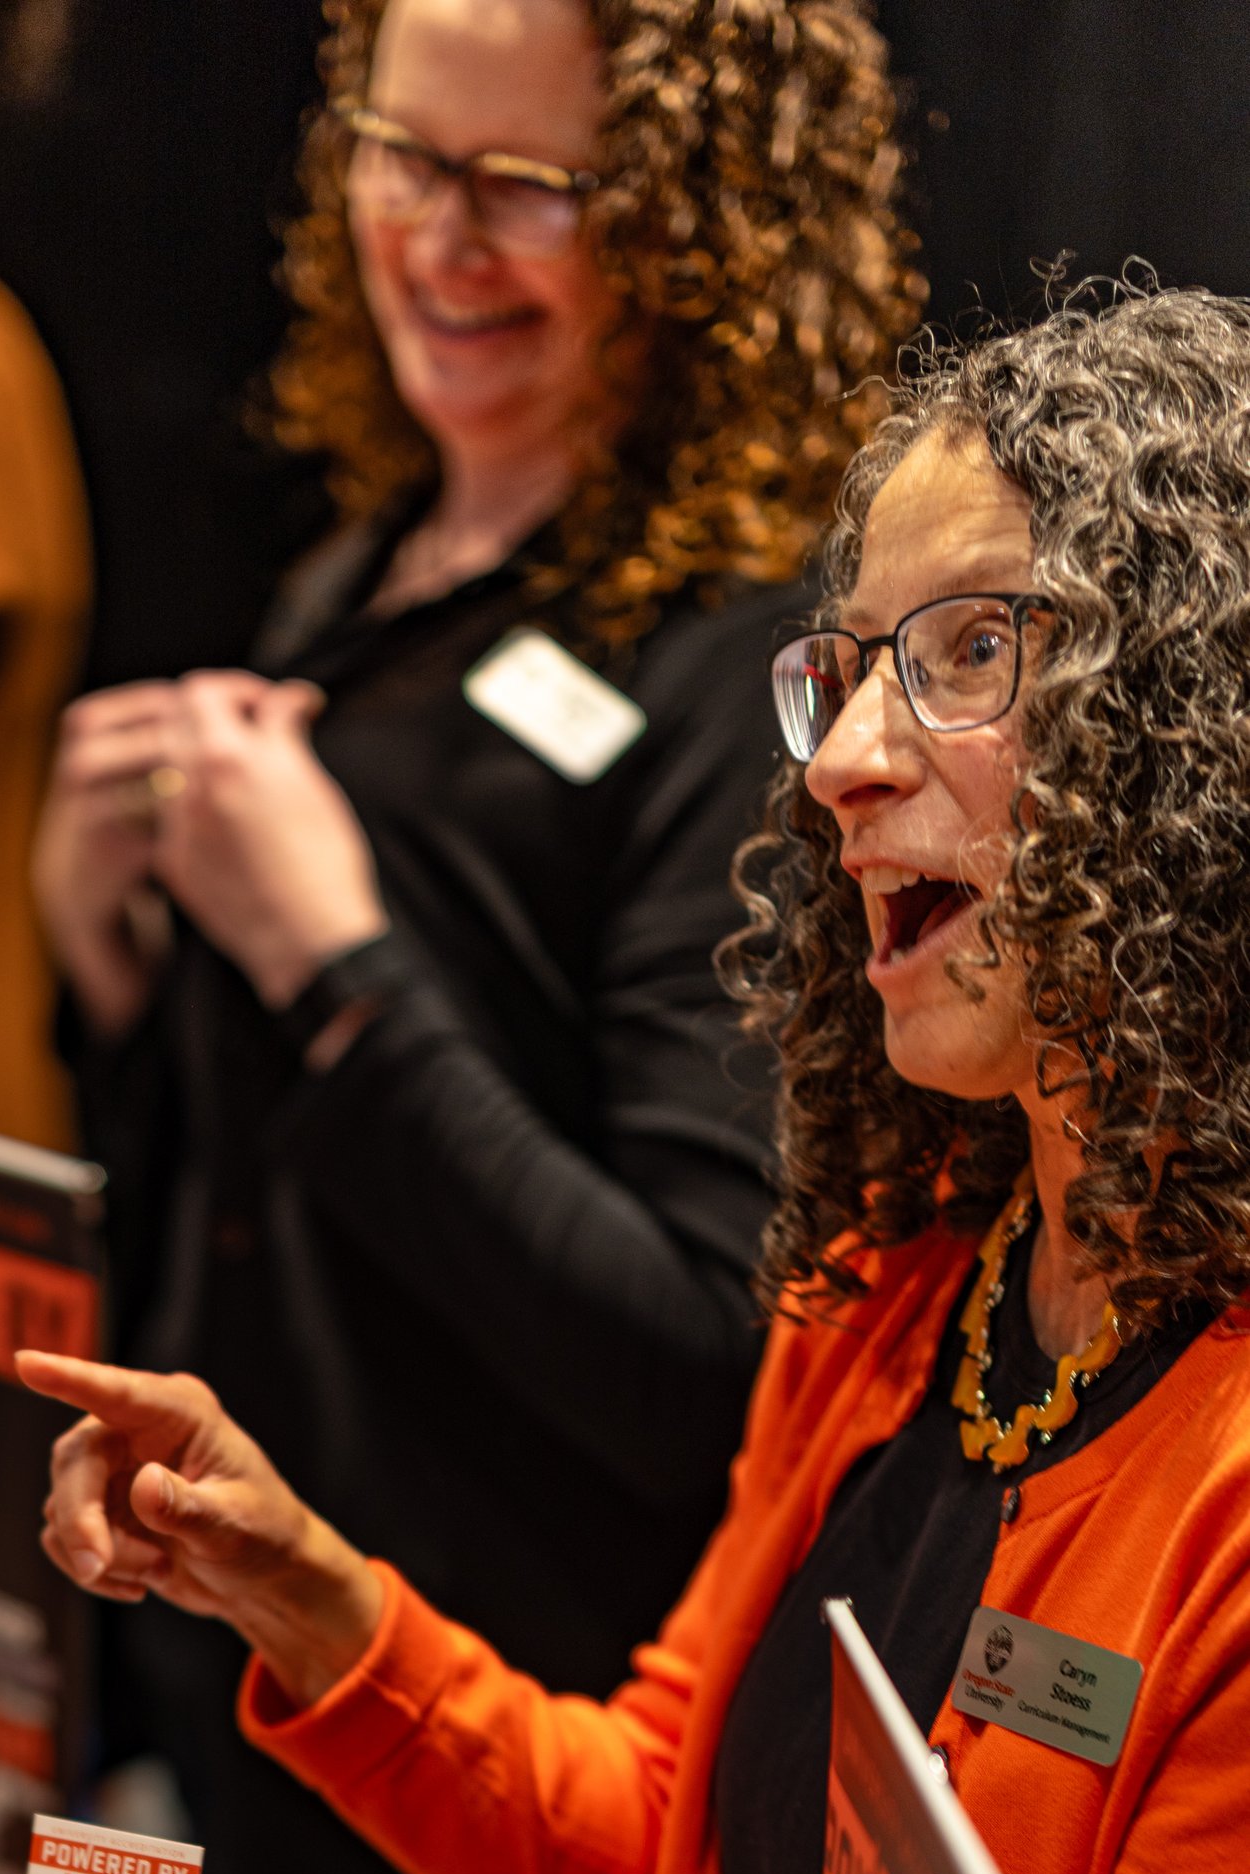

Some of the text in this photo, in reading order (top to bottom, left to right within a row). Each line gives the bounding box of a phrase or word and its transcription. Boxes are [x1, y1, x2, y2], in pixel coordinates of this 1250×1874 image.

[1059, 1659, 1098, 1688] Caryn
[964, 1685, 1005, 1712] University
[1061, 1714, 1111, 1744] Management
